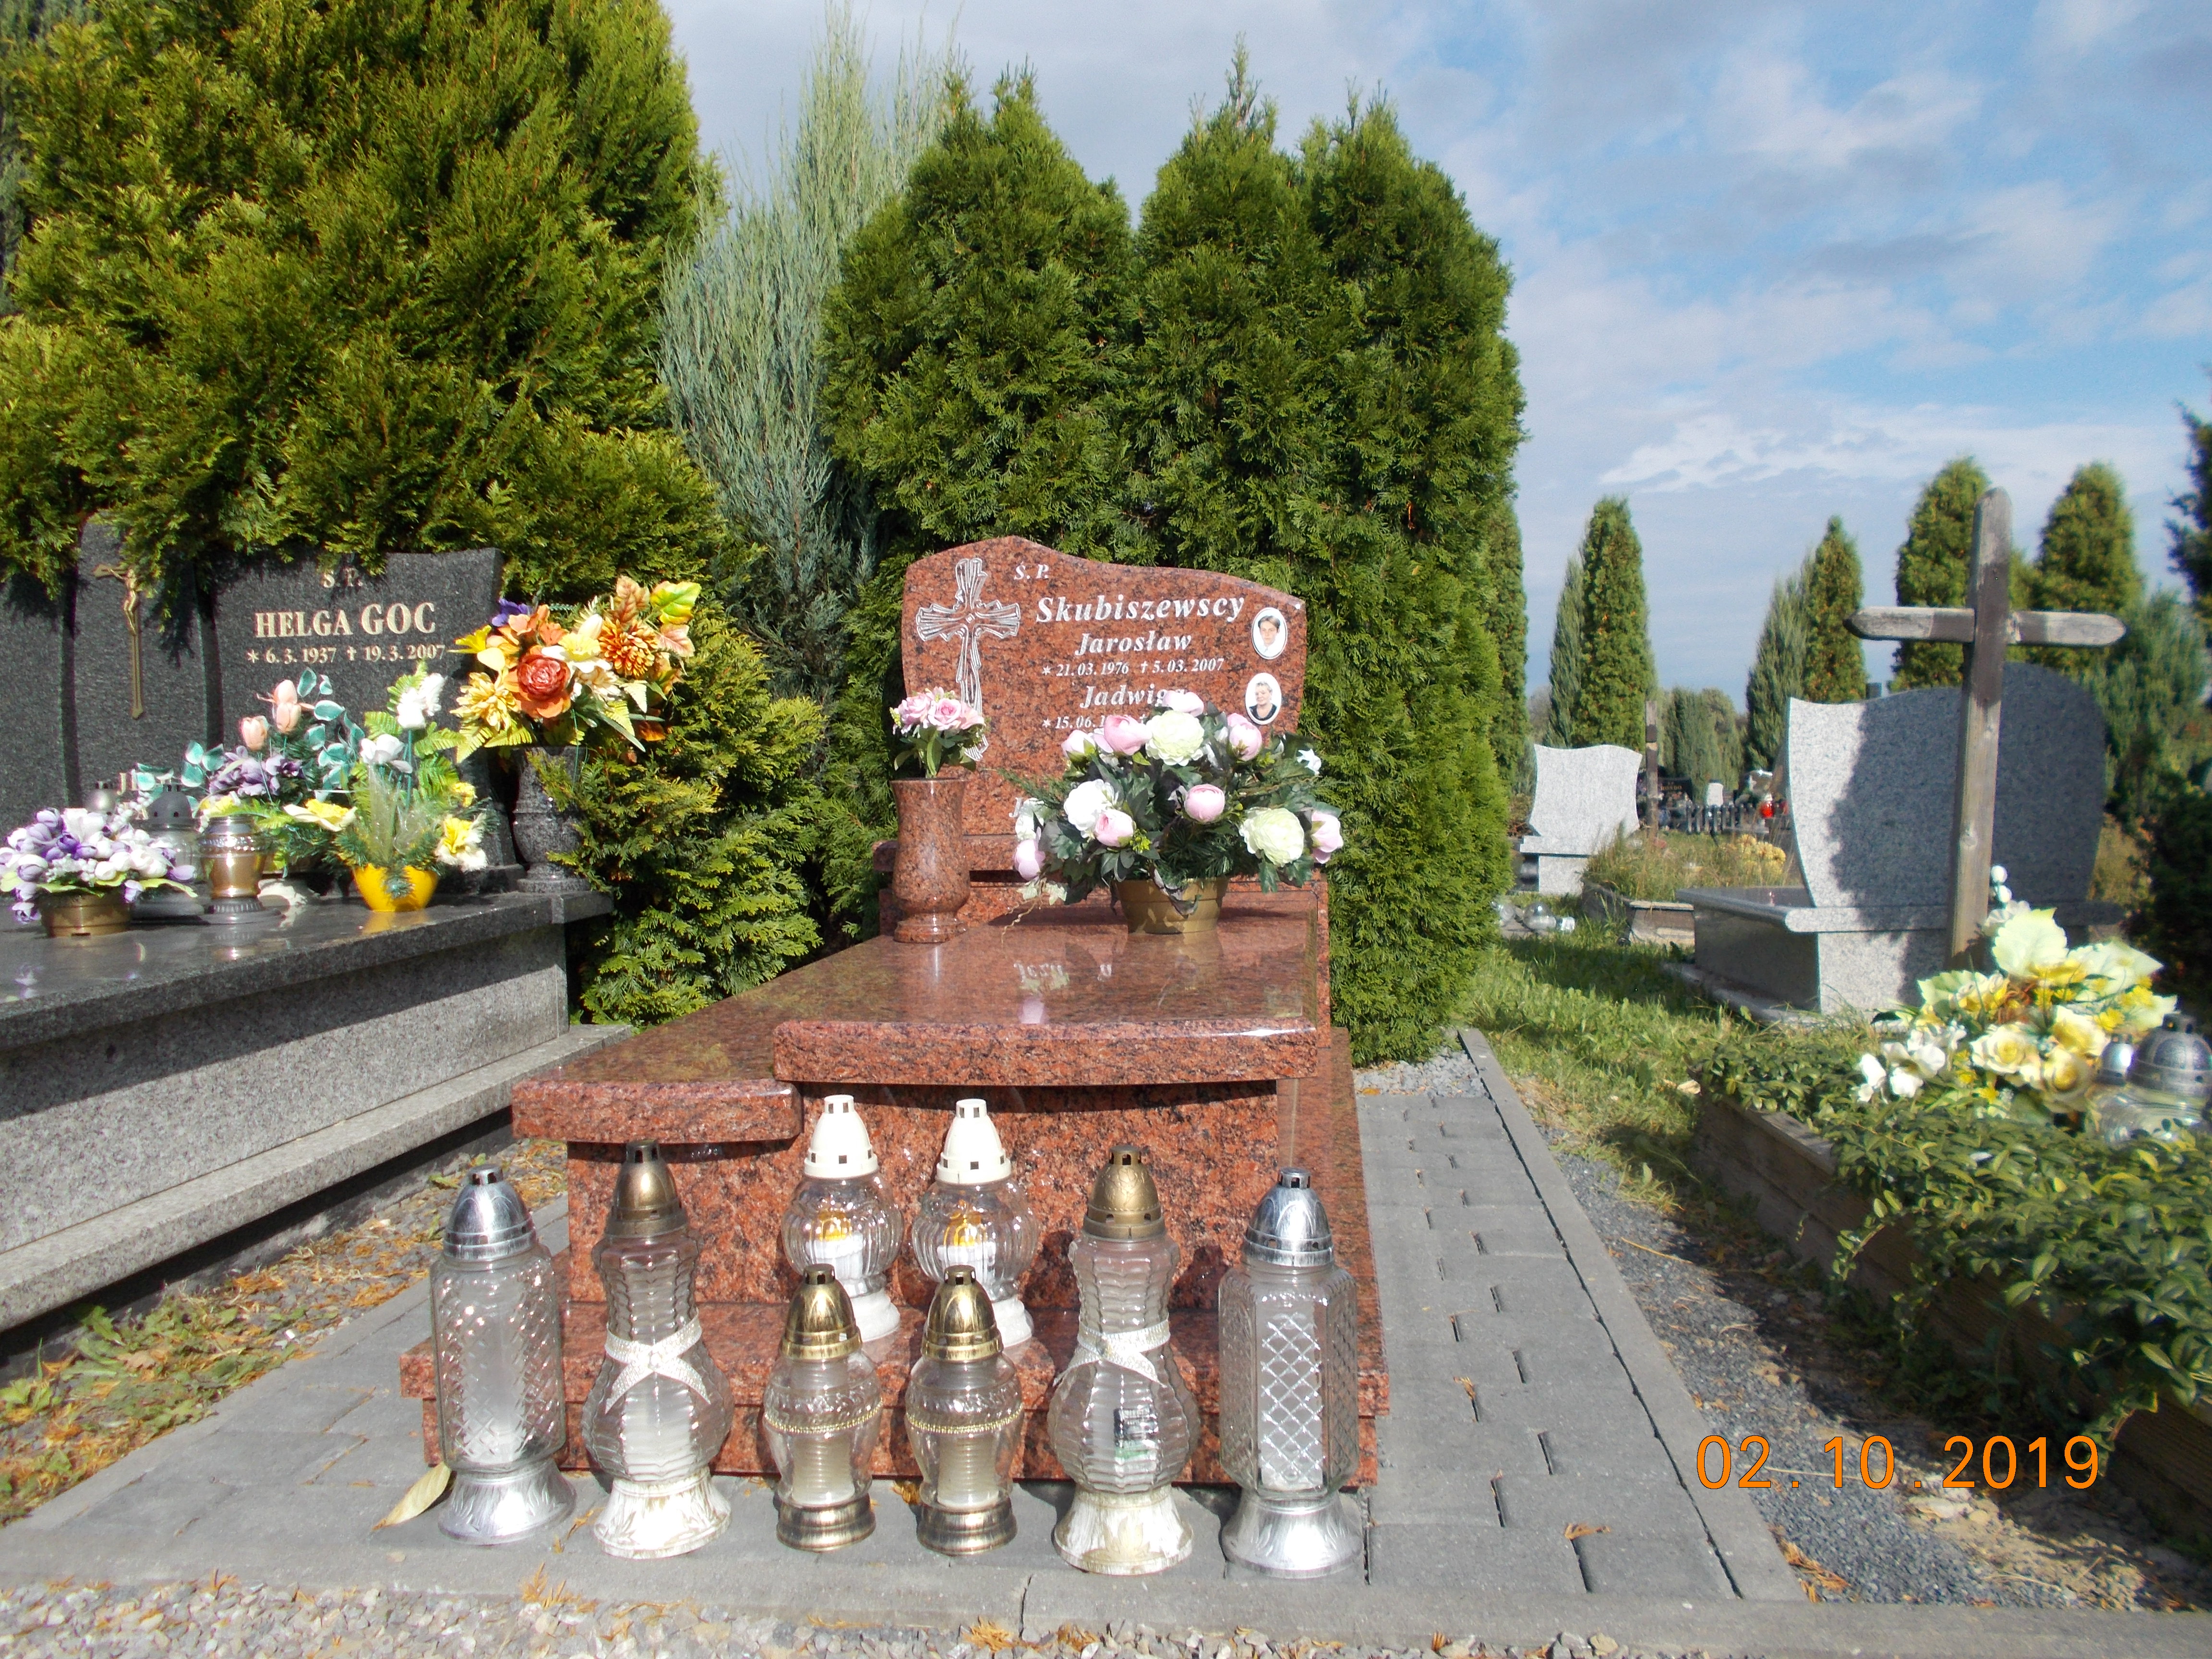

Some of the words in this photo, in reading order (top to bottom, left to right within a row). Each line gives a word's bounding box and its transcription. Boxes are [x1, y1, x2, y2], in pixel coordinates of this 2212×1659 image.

[255, 609, 353, 637] HELGA
[361, 602, 435, 635] GOC
[1036, 594, 1244, 623] Skubiszewscy
[1075, 630, 1192, 656] Jarosław
